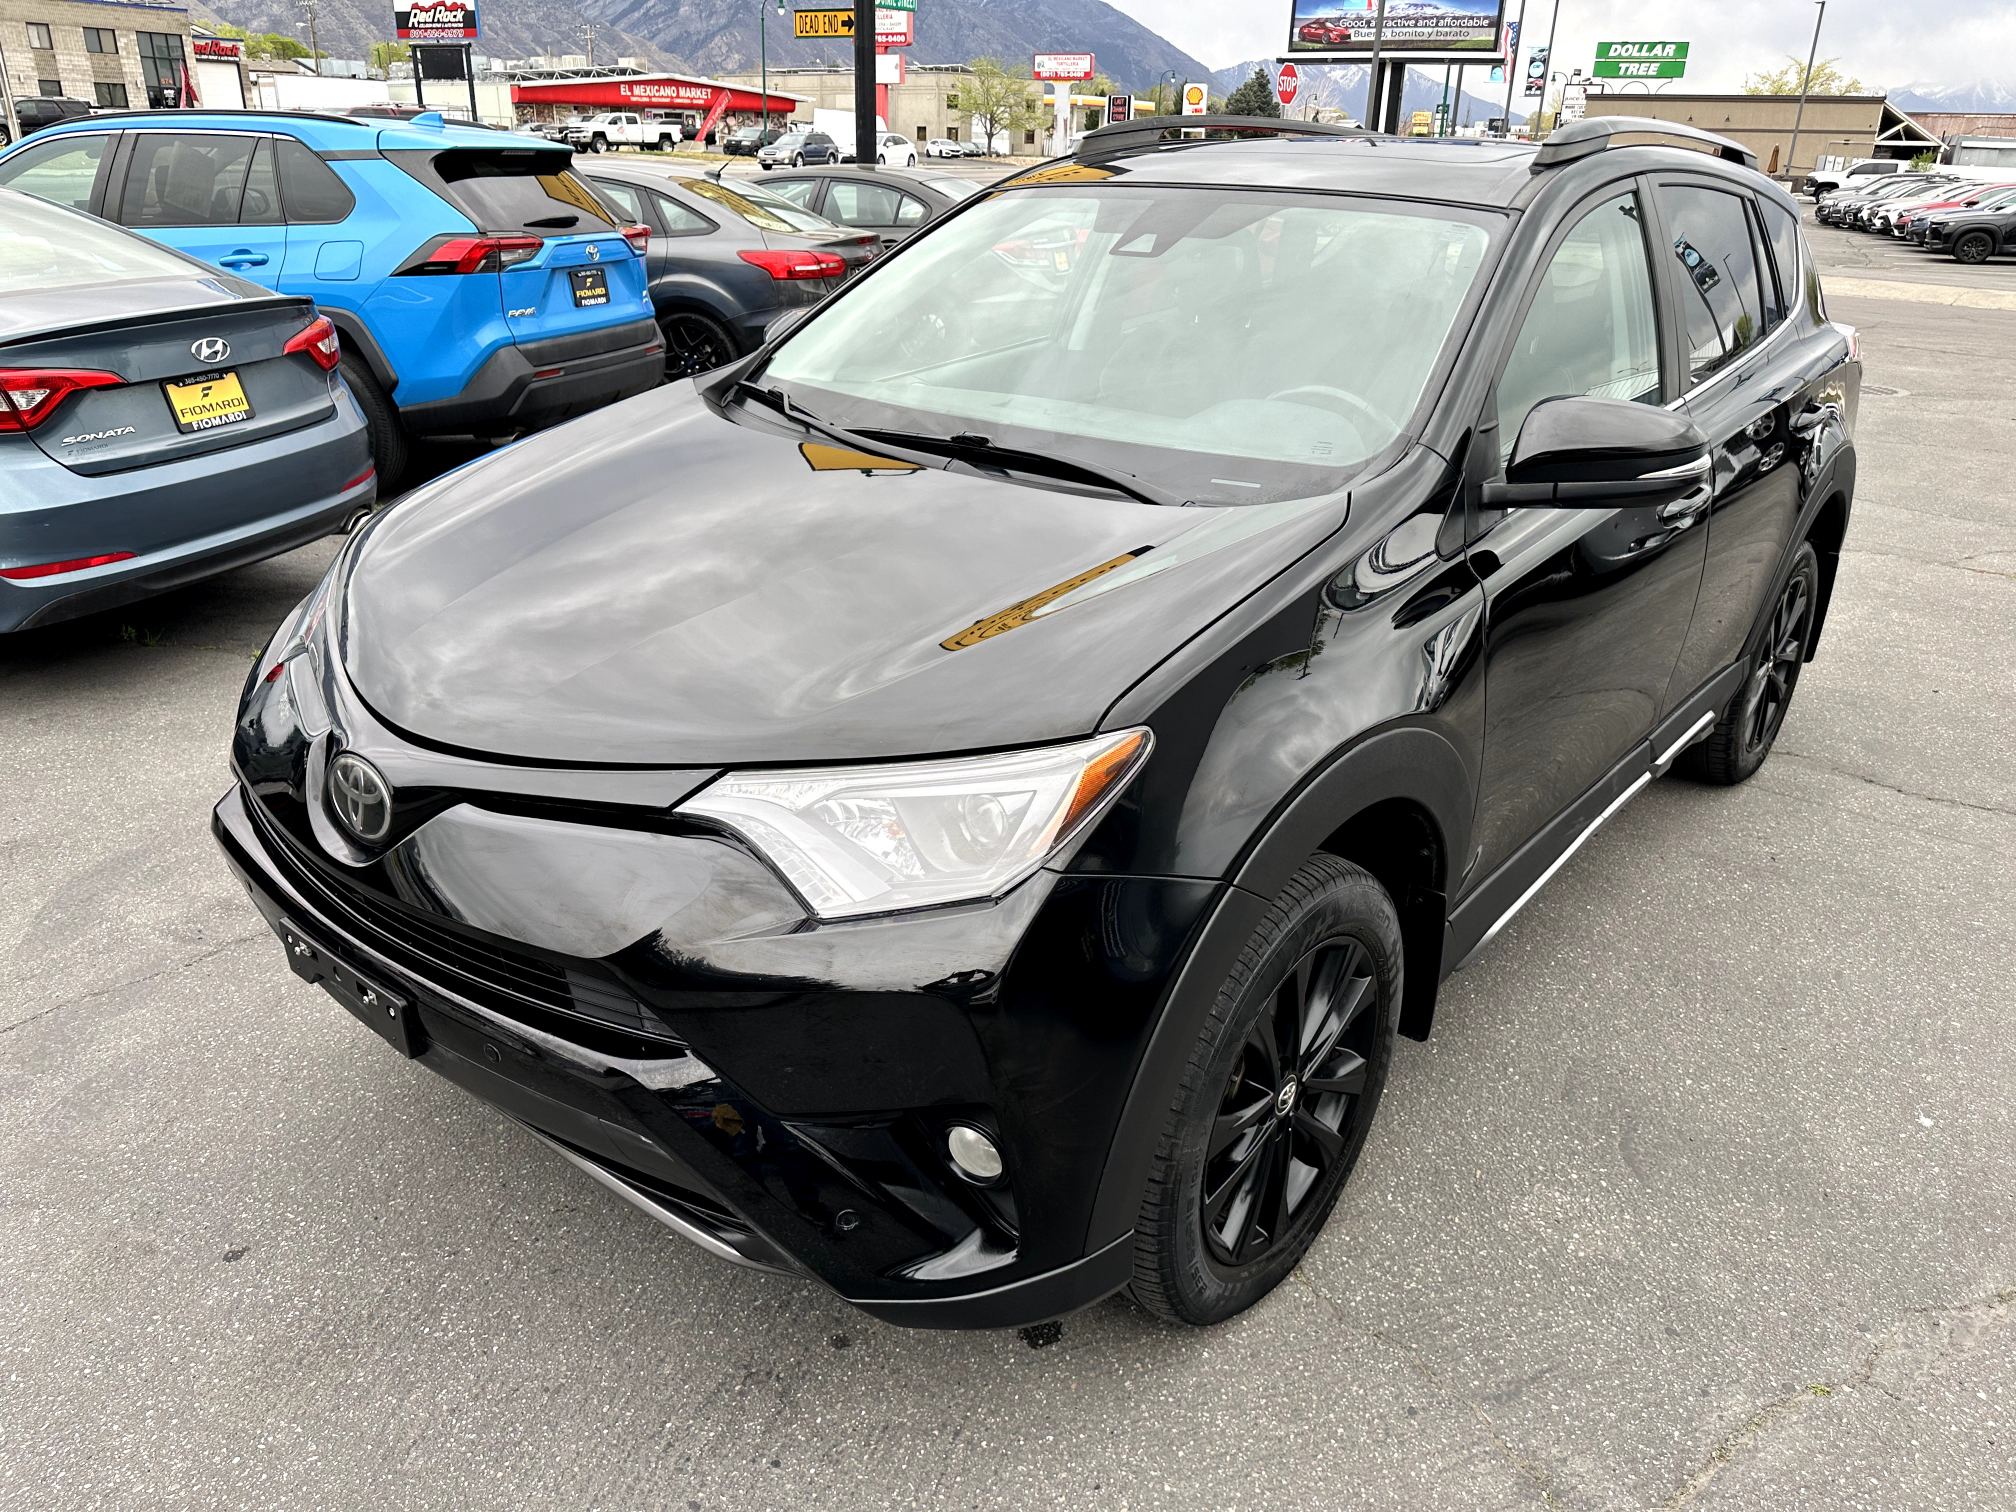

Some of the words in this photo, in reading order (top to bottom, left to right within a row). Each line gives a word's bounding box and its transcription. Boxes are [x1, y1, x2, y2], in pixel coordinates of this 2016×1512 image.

[408, 8, 435, 27] Red
[434, 6, 465, 22] Rock
[800, 15, 819, 34] DEAD
[823, 14, 839, 33] END
[1340, 18, 1368, 29] Good,
[1417, 17, 1436, 27] and
[1438, 17, 1489, 27] affordable
[1391, 29, 1425, 37] bonito
[1427, 30, 1434, 38] y
[1436, 29, 1470, 37] barato
[210, 39, 240, 57] Rock
[1608, 43, 1676, 57] DOLLAR
[1618, 62, 1660, 76] TREE
[620, 84, 631, 96] EL
[633, 84, 677, 97] MEXICANO
[678, 86, 712, 99] MARKET
[1278, 75, 1297, 92] STOP
[576, 287, 606, 298] FIOMARDI
[180, 397, 245, 418] FIOMARDI
[191, 410, 247, 430] FIOMARDI
[61, 426, 136, 447] SONATA
